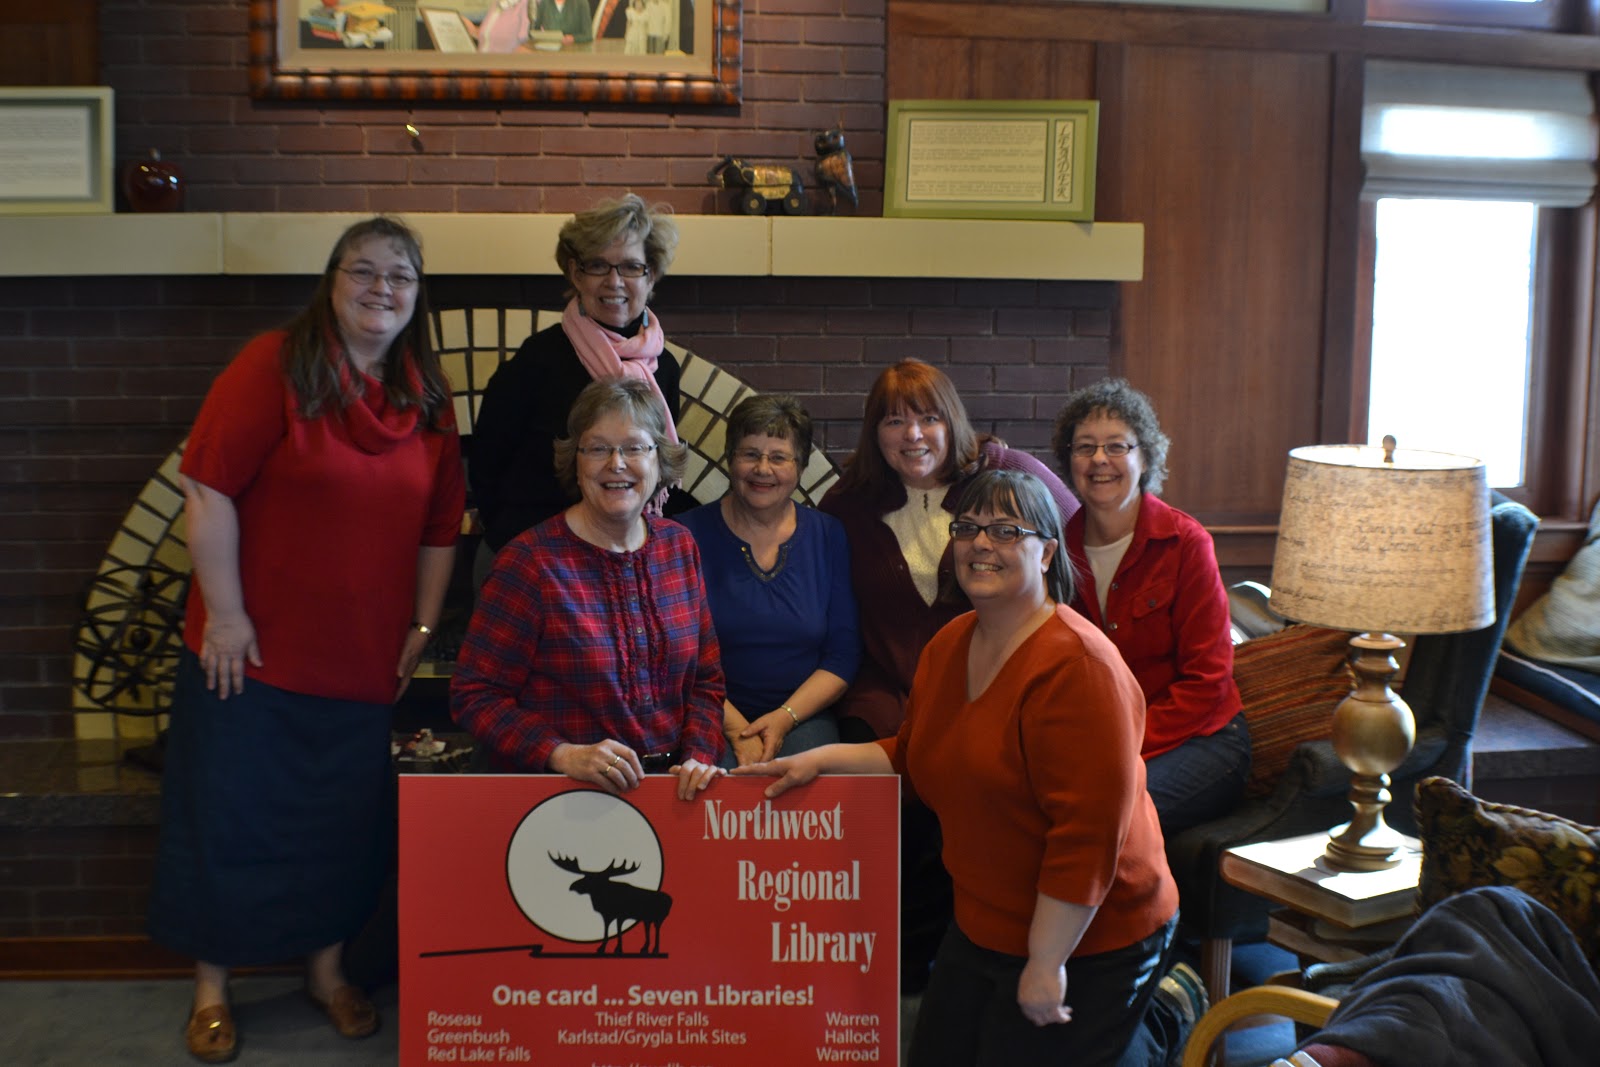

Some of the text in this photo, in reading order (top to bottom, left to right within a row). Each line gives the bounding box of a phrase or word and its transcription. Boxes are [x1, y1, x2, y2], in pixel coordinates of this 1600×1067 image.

[703, 799, 844, 841] Northwest
[737, 860, 860, 912] Regional
[771, 922, 877, 973] Library
[492, 984, 542, 1006] One
[546, 984, 598, 1006] card
[627, 984, 699, 1006] Seven
[704, 984, 814, 1006] Libraries!
[427, 1011, 482, 1026] Roseau
[595, 1011, 709, 1027] Thief River Falls
[825, 1011, 880, 1027] Warren
[427, 1028, 510, 1044] Greenbush
[557, 1029, 747, 1048] Karlstad/Grygla Link Sites
[825, 1028, 880, 1044] Hallock
[427, 1046, 531, 1062] Red Lake Falls
[816, 1046, 880, 1062] Warroad
